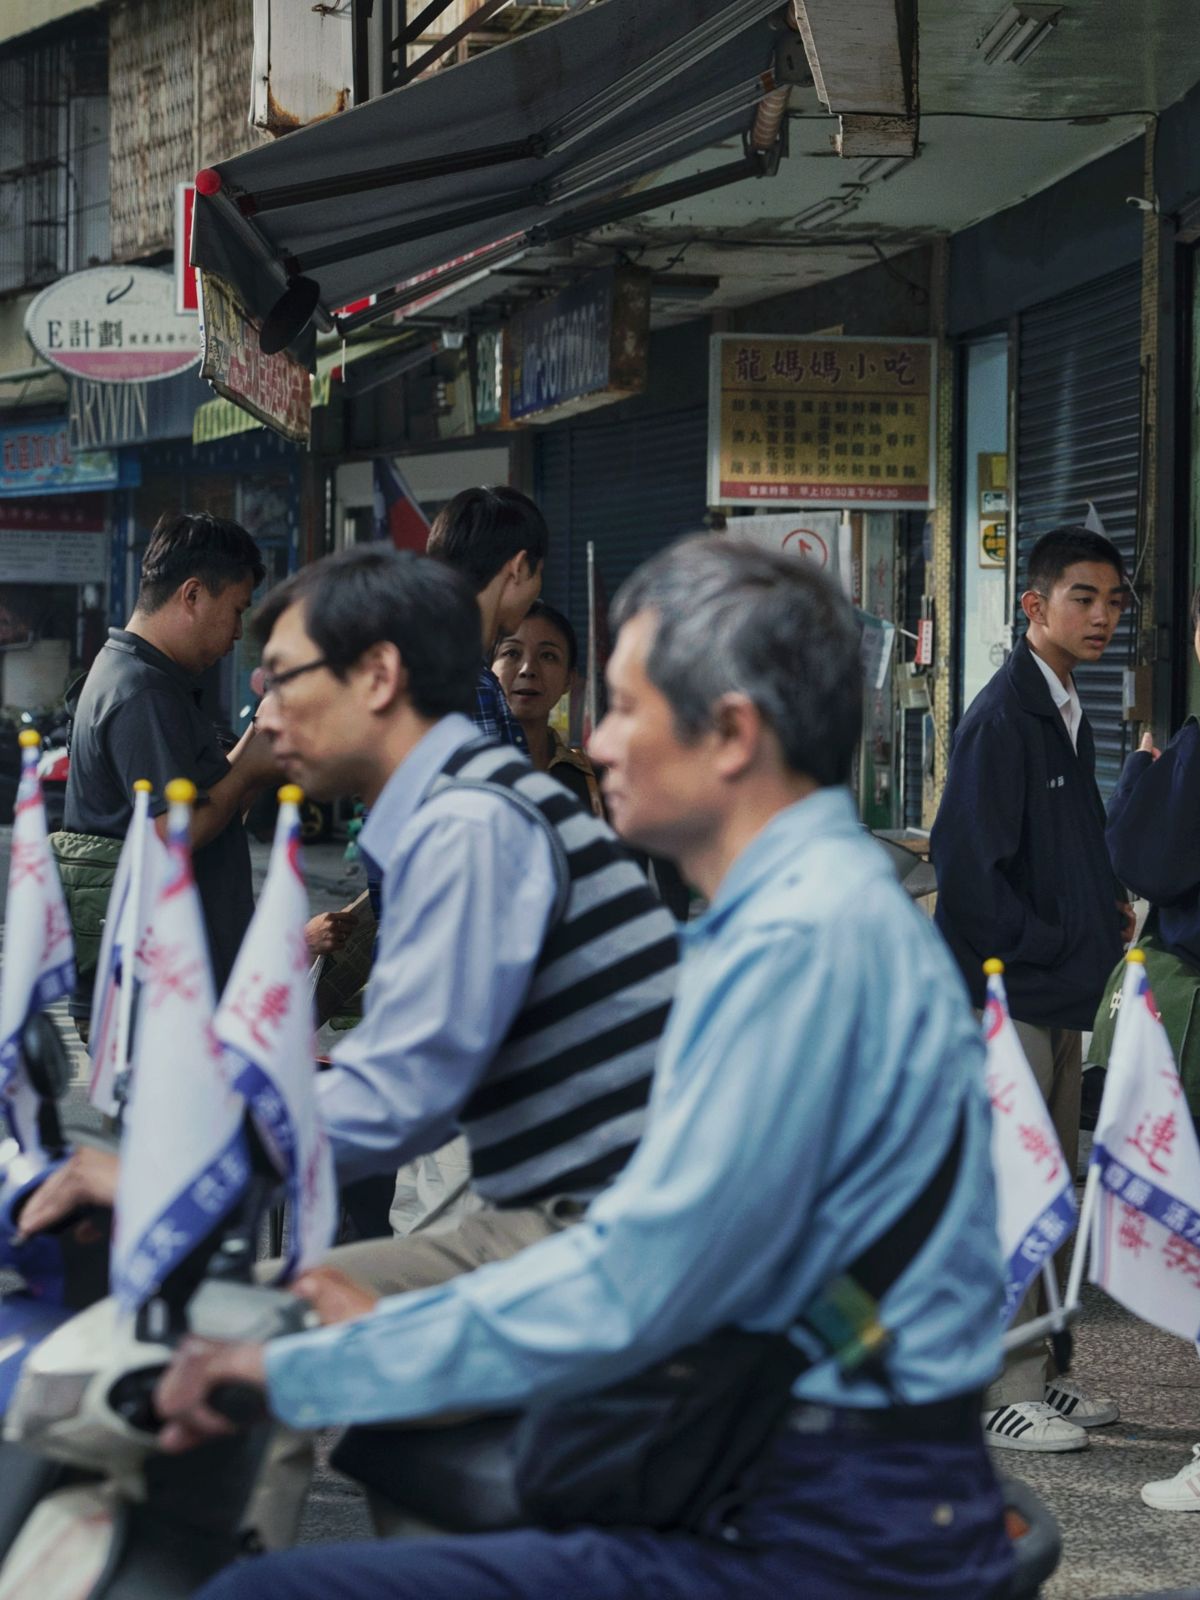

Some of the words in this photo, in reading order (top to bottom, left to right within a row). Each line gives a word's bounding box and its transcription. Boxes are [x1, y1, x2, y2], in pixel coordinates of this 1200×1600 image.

[47, 319, 123, 348] E計劃
[735, 348, 916, 386] 龍媽媽小吃
